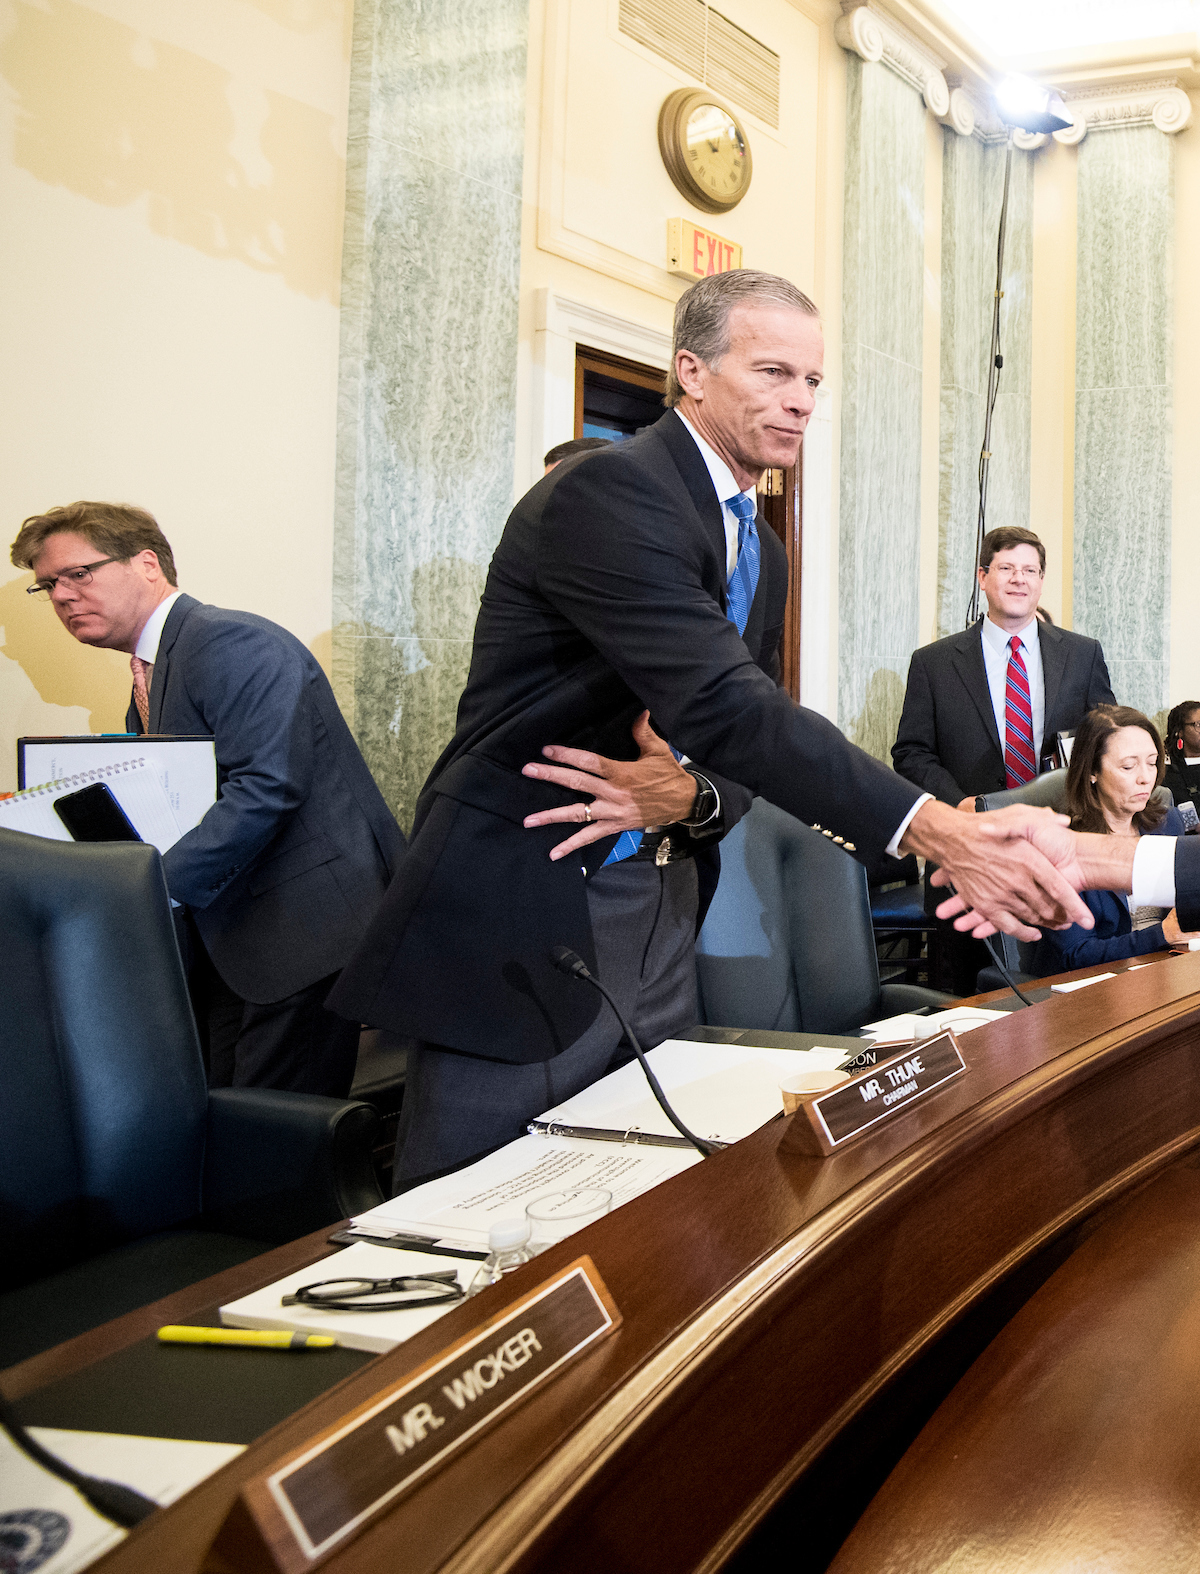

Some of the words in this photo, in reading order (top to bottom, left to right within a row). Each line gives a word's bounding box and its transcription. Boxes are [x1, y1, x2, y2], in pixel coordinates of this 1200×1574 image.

[694, 230, 734, 277] EXIT
[859, 1079, 885, 1102] MR.
[885, 1056, 925, 1087] THUNE
[882, 1080, 919, 1106] CHAIRMAN
[385, 1402, 446, 1456] MR.
[442, 1328, 543, 1410] WICKER
